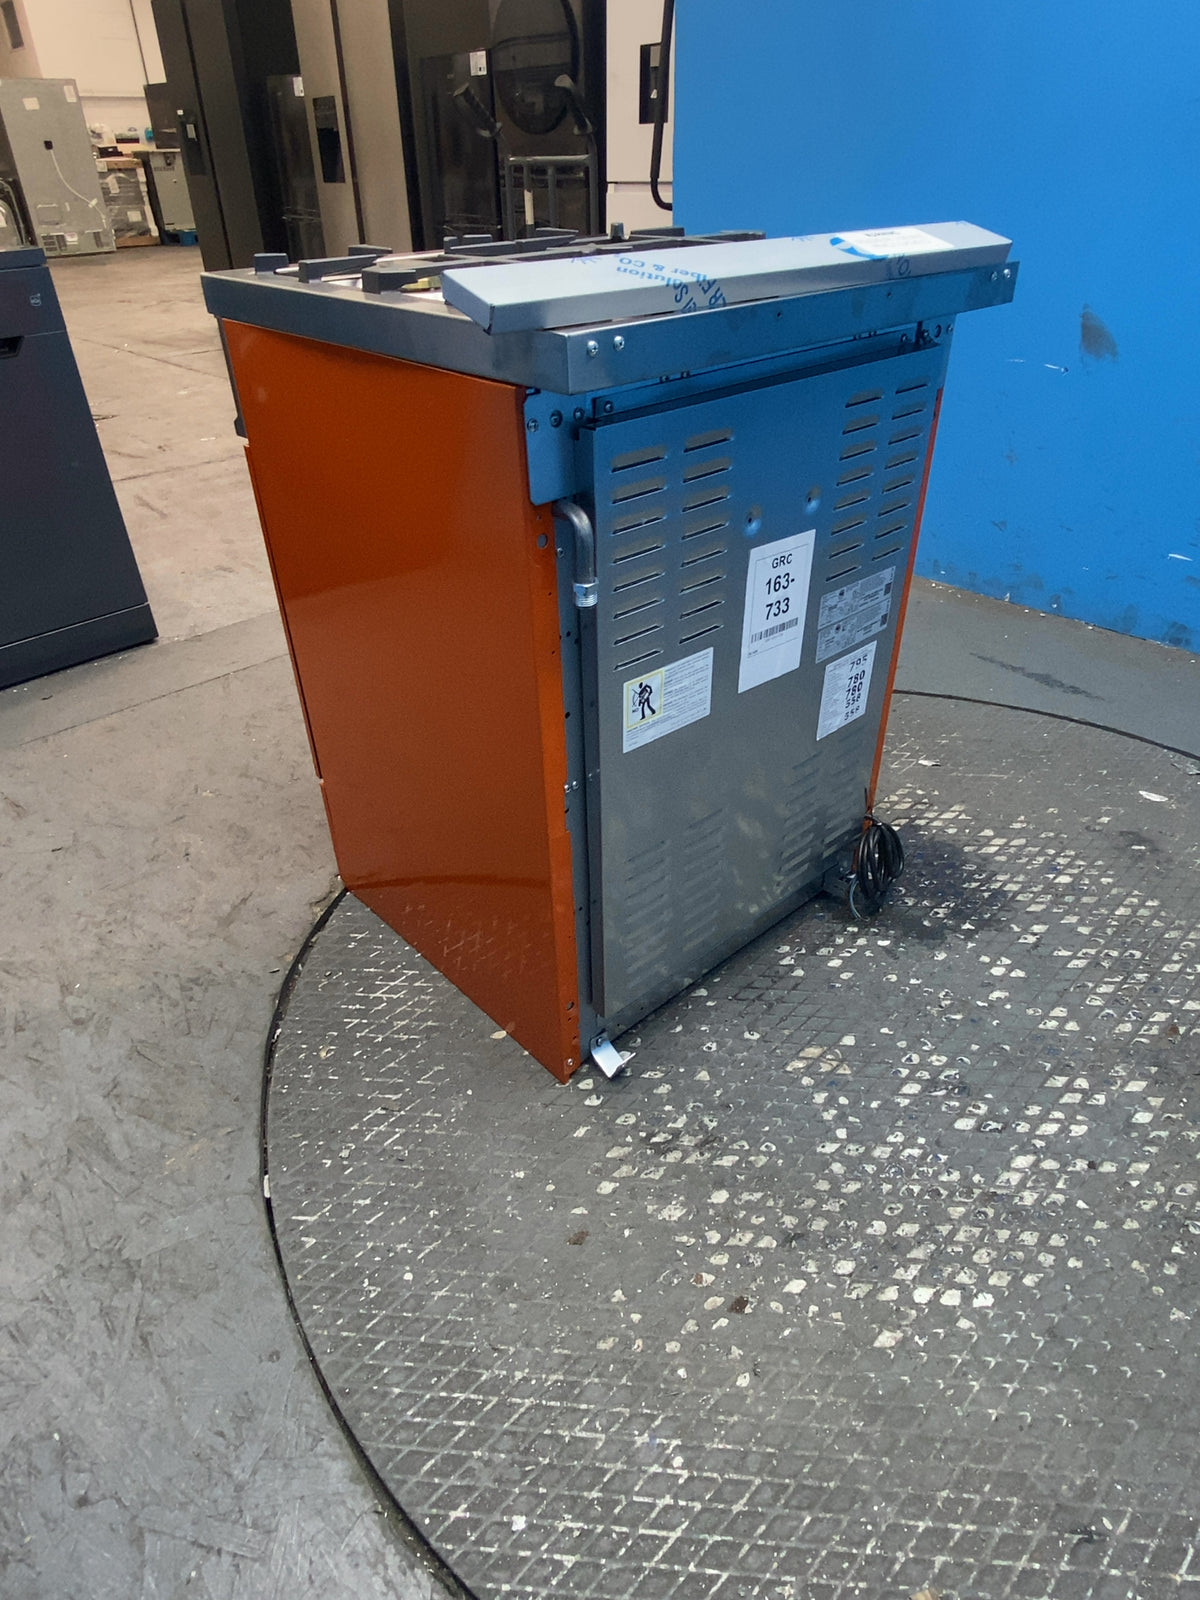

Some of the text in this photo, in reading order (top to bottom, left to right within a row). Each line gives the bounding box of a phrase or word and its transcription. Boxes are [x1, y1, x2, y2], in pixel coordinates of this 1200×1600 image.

[652, 263, 665, 272] &
[616, 266, 689, 303] Solution
[772, 553, 793, 569] GRC
[766, 572, 795, 595] 163-
[766, 597, 790, 620] 733
